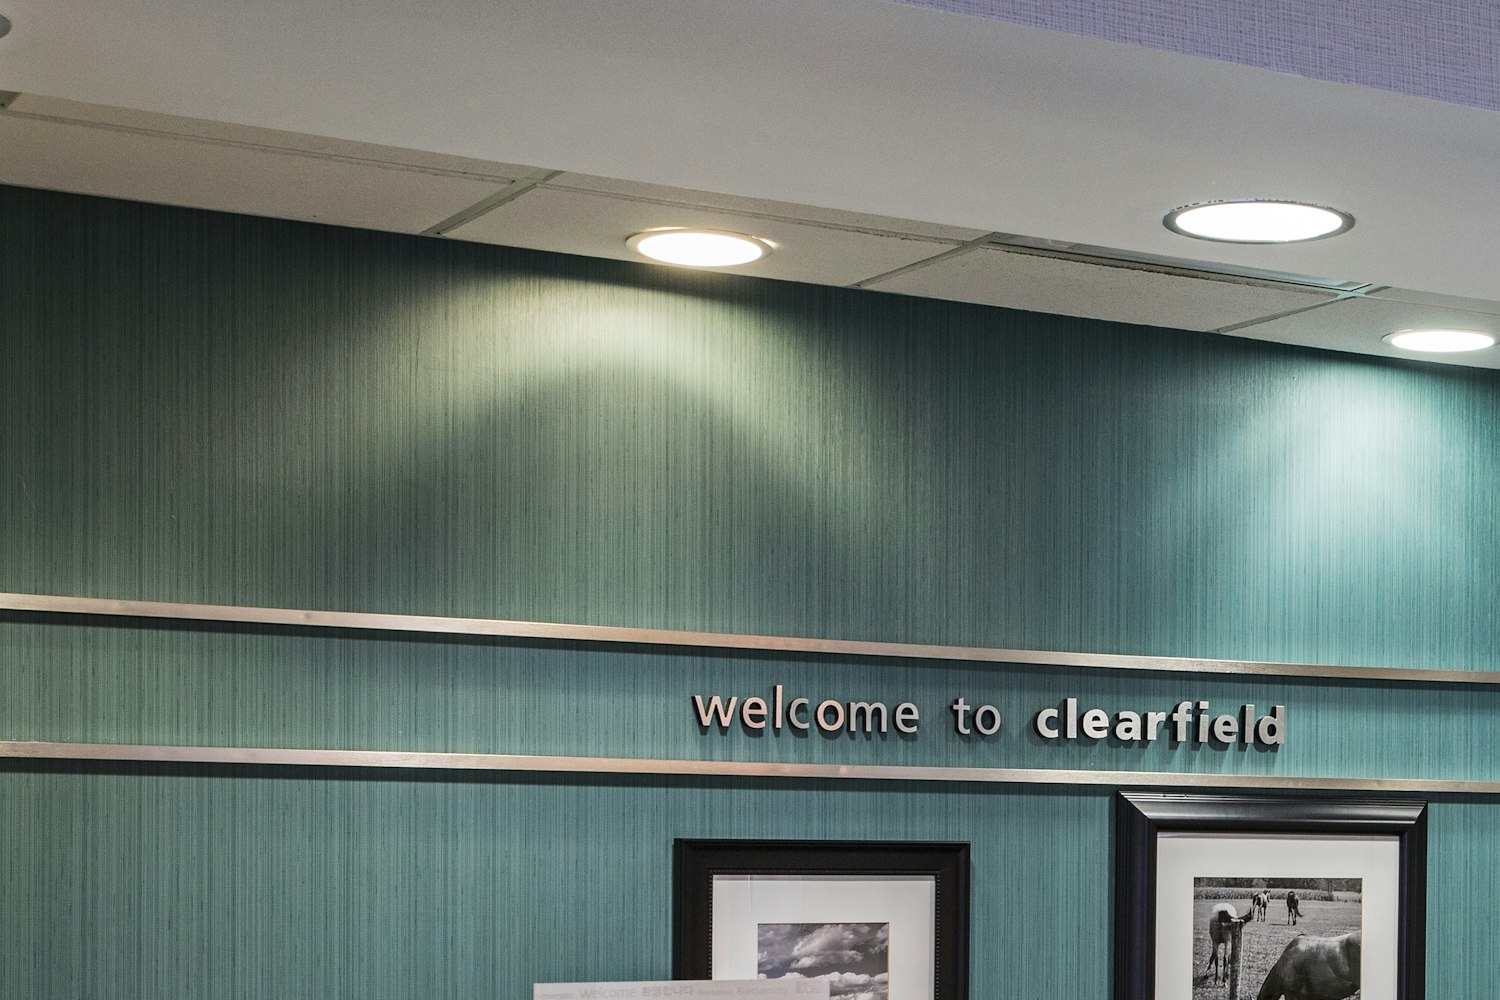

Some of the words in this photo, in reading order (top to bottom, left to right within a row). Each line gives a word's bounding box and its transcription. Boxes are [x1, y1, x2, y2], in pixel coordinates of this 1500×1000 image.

[691, 684, 920, 734] welcome
[953, 697, 1002, 737] to
[1035, 697, 1286, 745] clearfield
